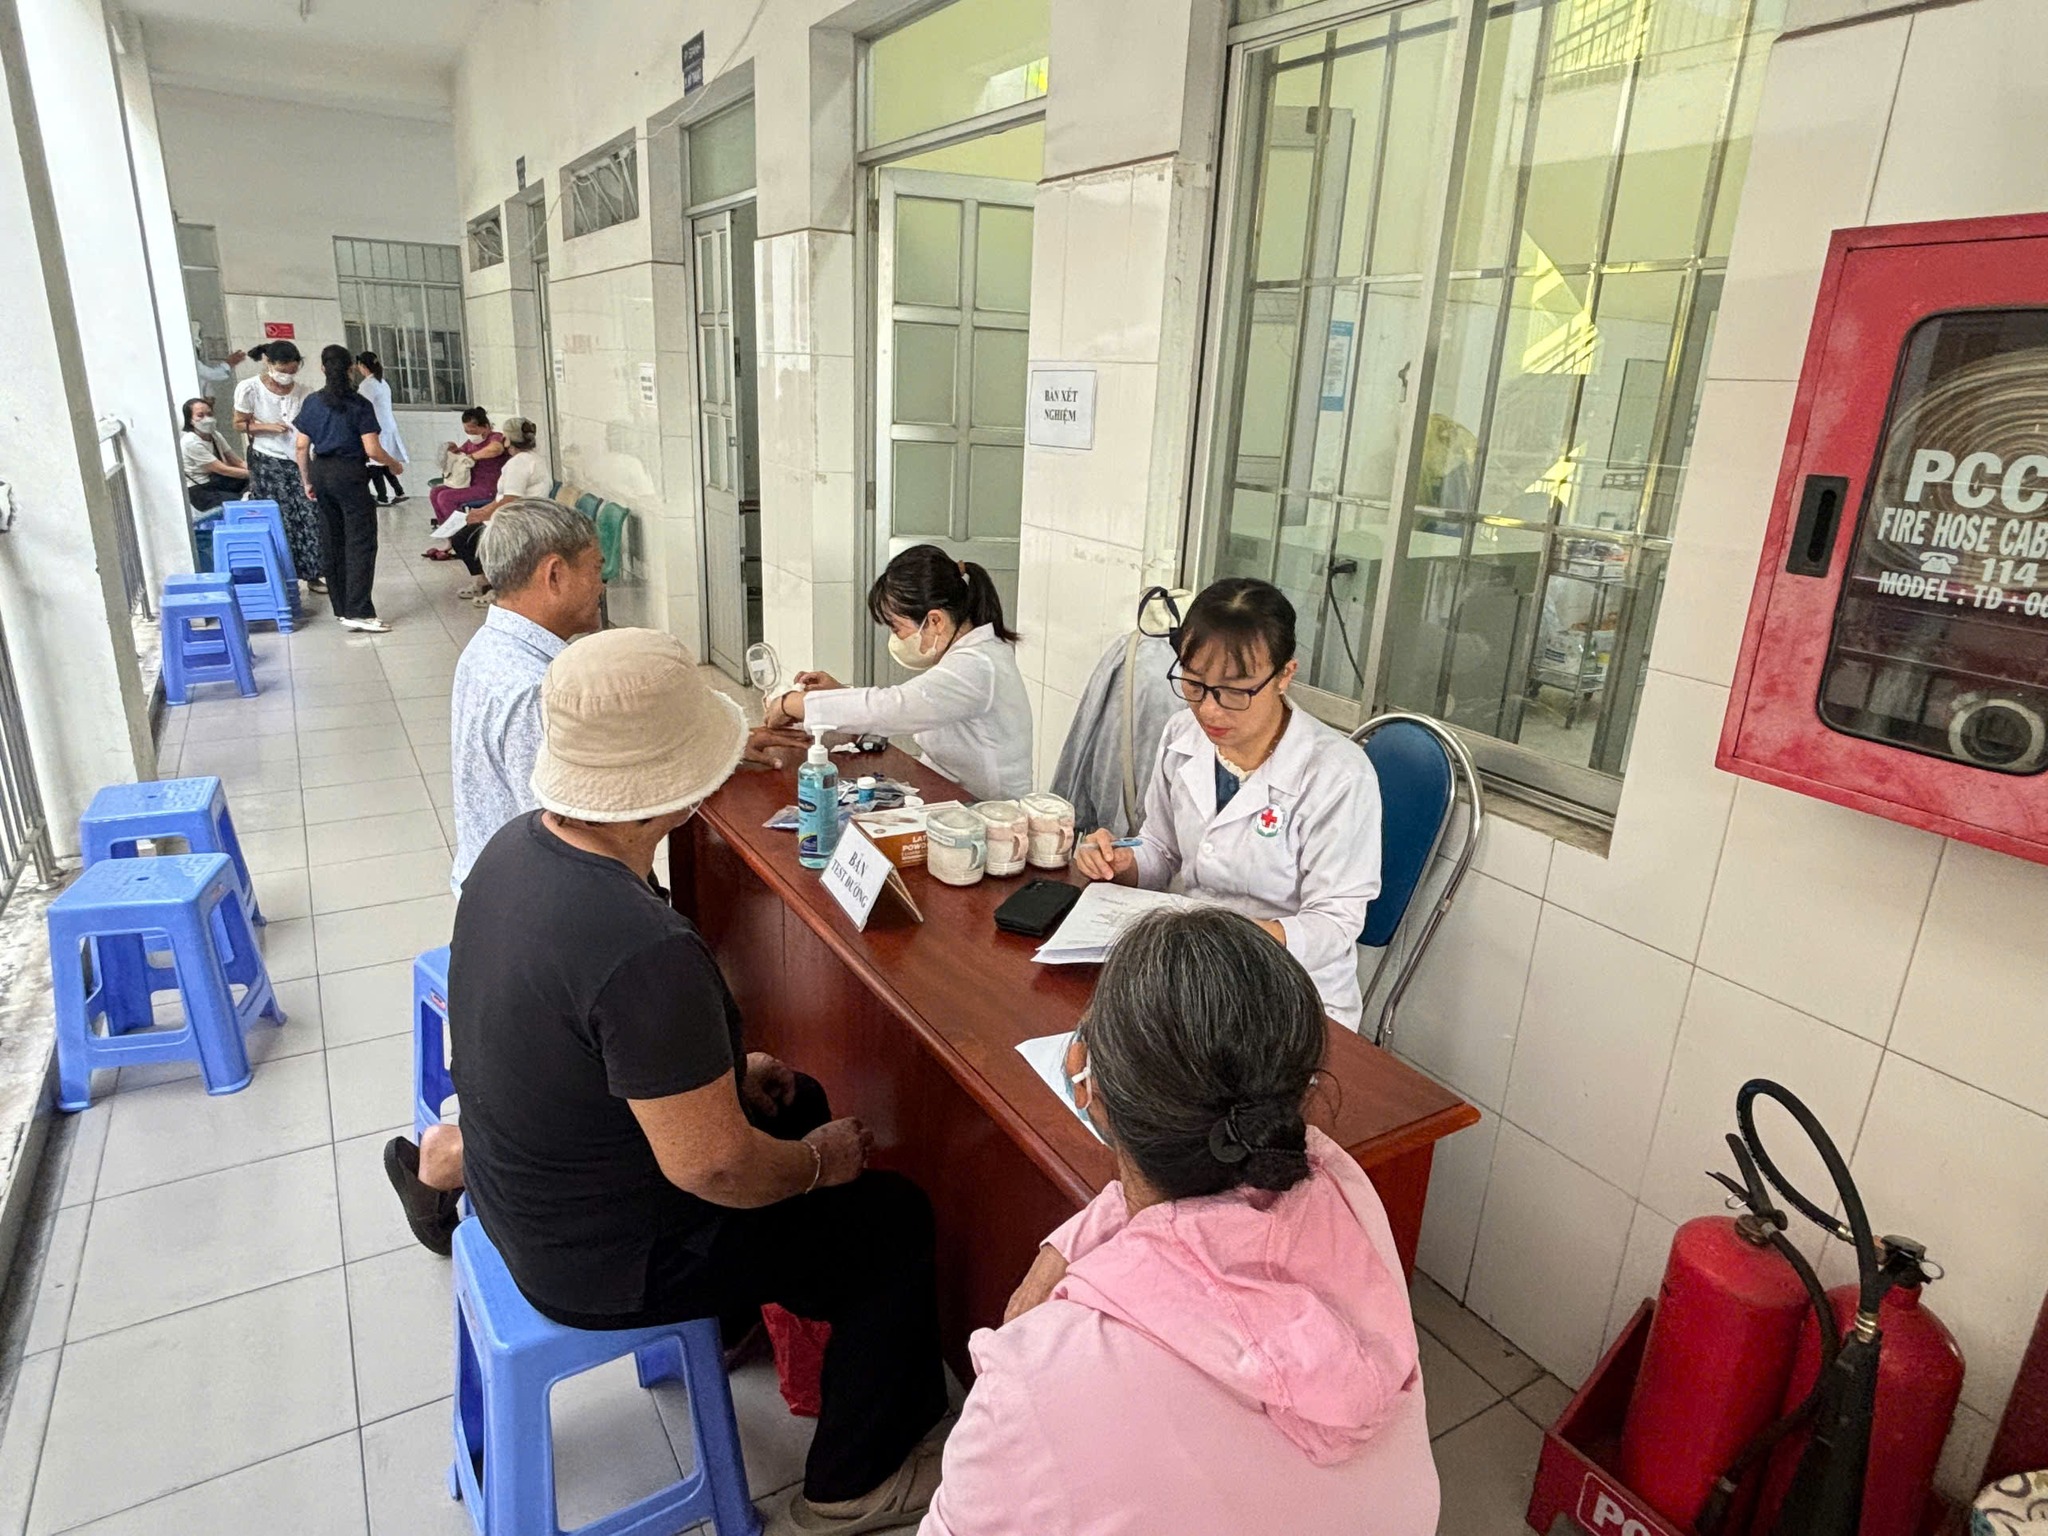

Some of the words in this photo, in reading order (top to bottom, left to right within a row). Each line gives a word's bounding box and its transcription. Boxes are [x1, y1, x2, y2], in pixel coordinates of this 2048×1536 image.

[1044, 407, 1077, 424] NGHIỆM
[1904, 448, 2048, 513] PCC
[1877, 507, 1931, 546] FIRE
[1931, 512, 1997, 552] HOSE
[1999, 518, 2048, 560] CAB
[1981, 557, 2040, 588] 114
[1877, 570, 1950, 603] MODEL
[1973, 584, 2004, 611] TD
[902, 842, 927, 851] POWD
[912, 835, 927, 843] LAT
[831, 859, 848, 882] TEST
